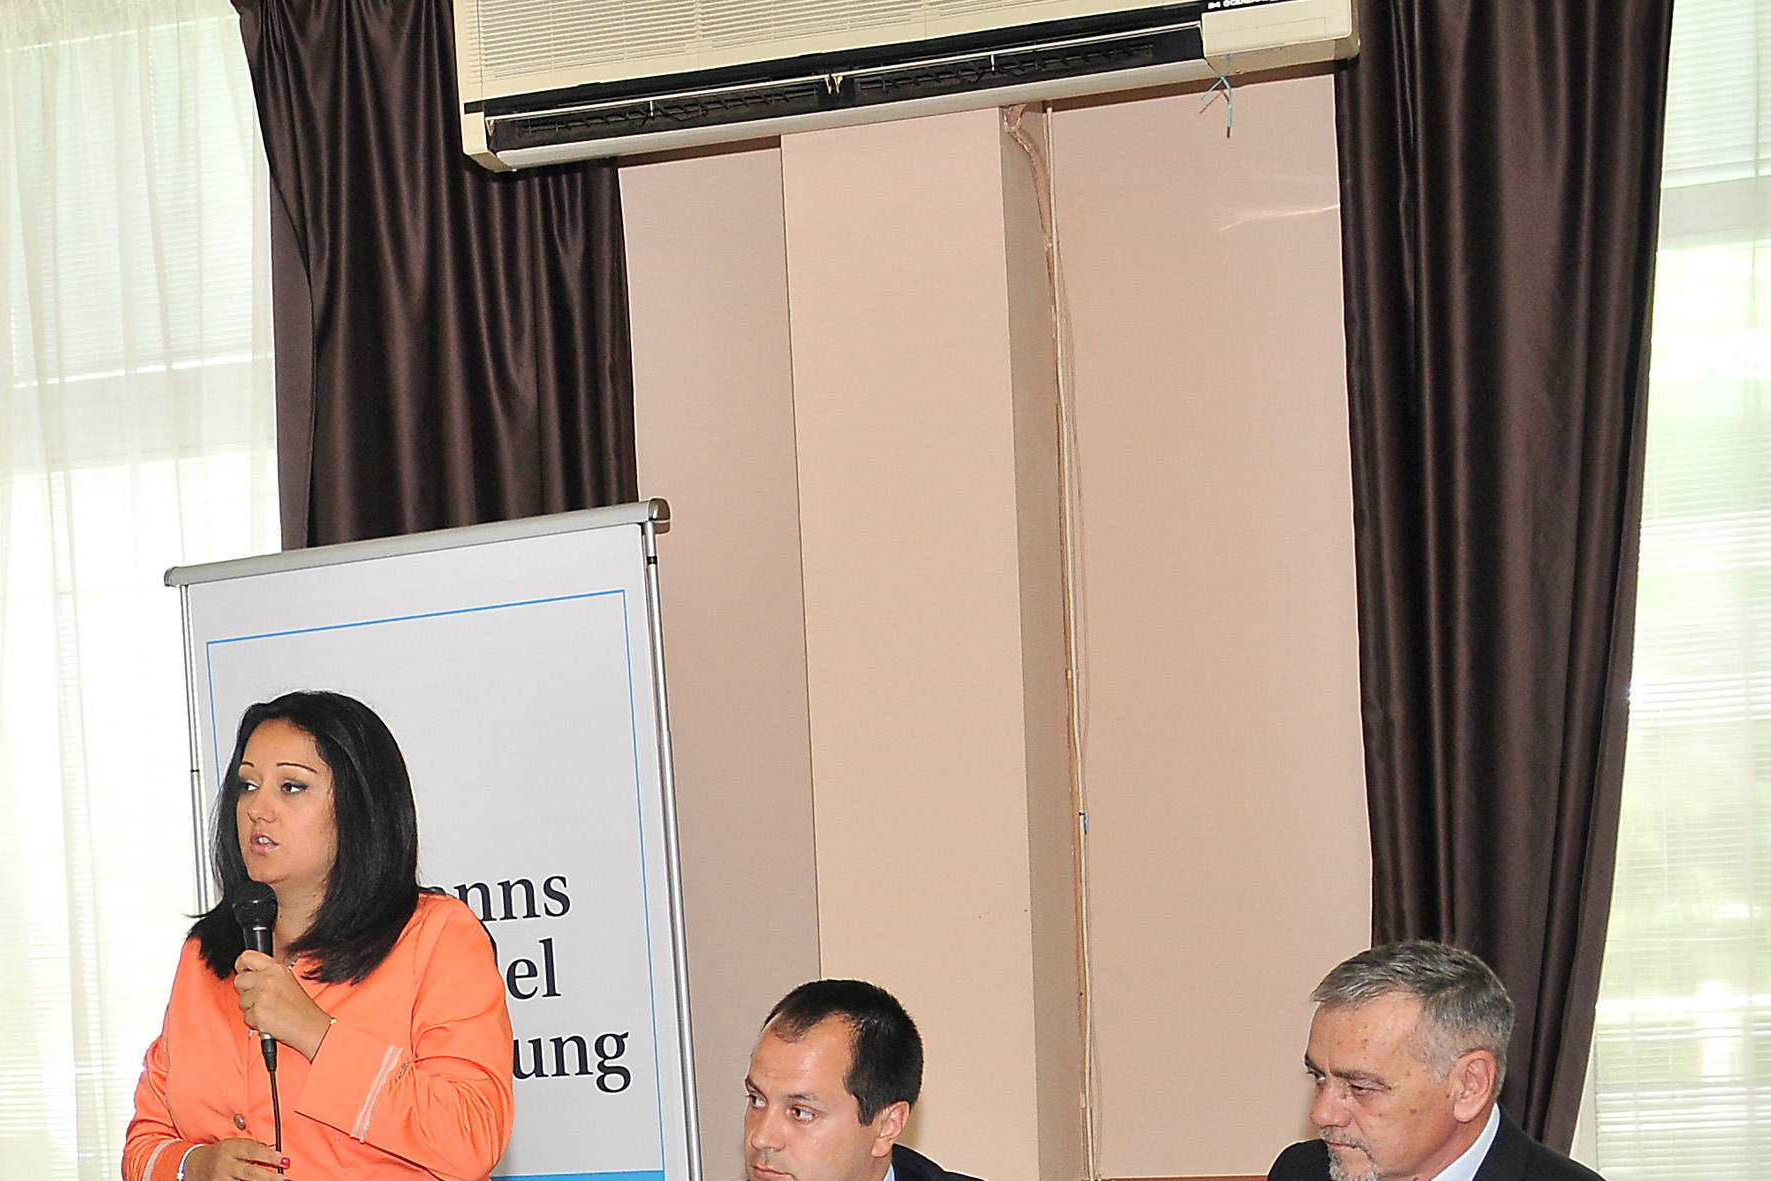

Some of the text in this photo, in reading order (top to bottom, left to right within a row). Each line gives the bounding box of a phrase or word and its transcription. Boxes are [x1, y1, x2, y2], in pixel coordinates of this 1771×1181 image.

[453, 875, 571, 922] nns
[506, 937, 562, 1000] el
[513, 1031, 631, 1093] ung
